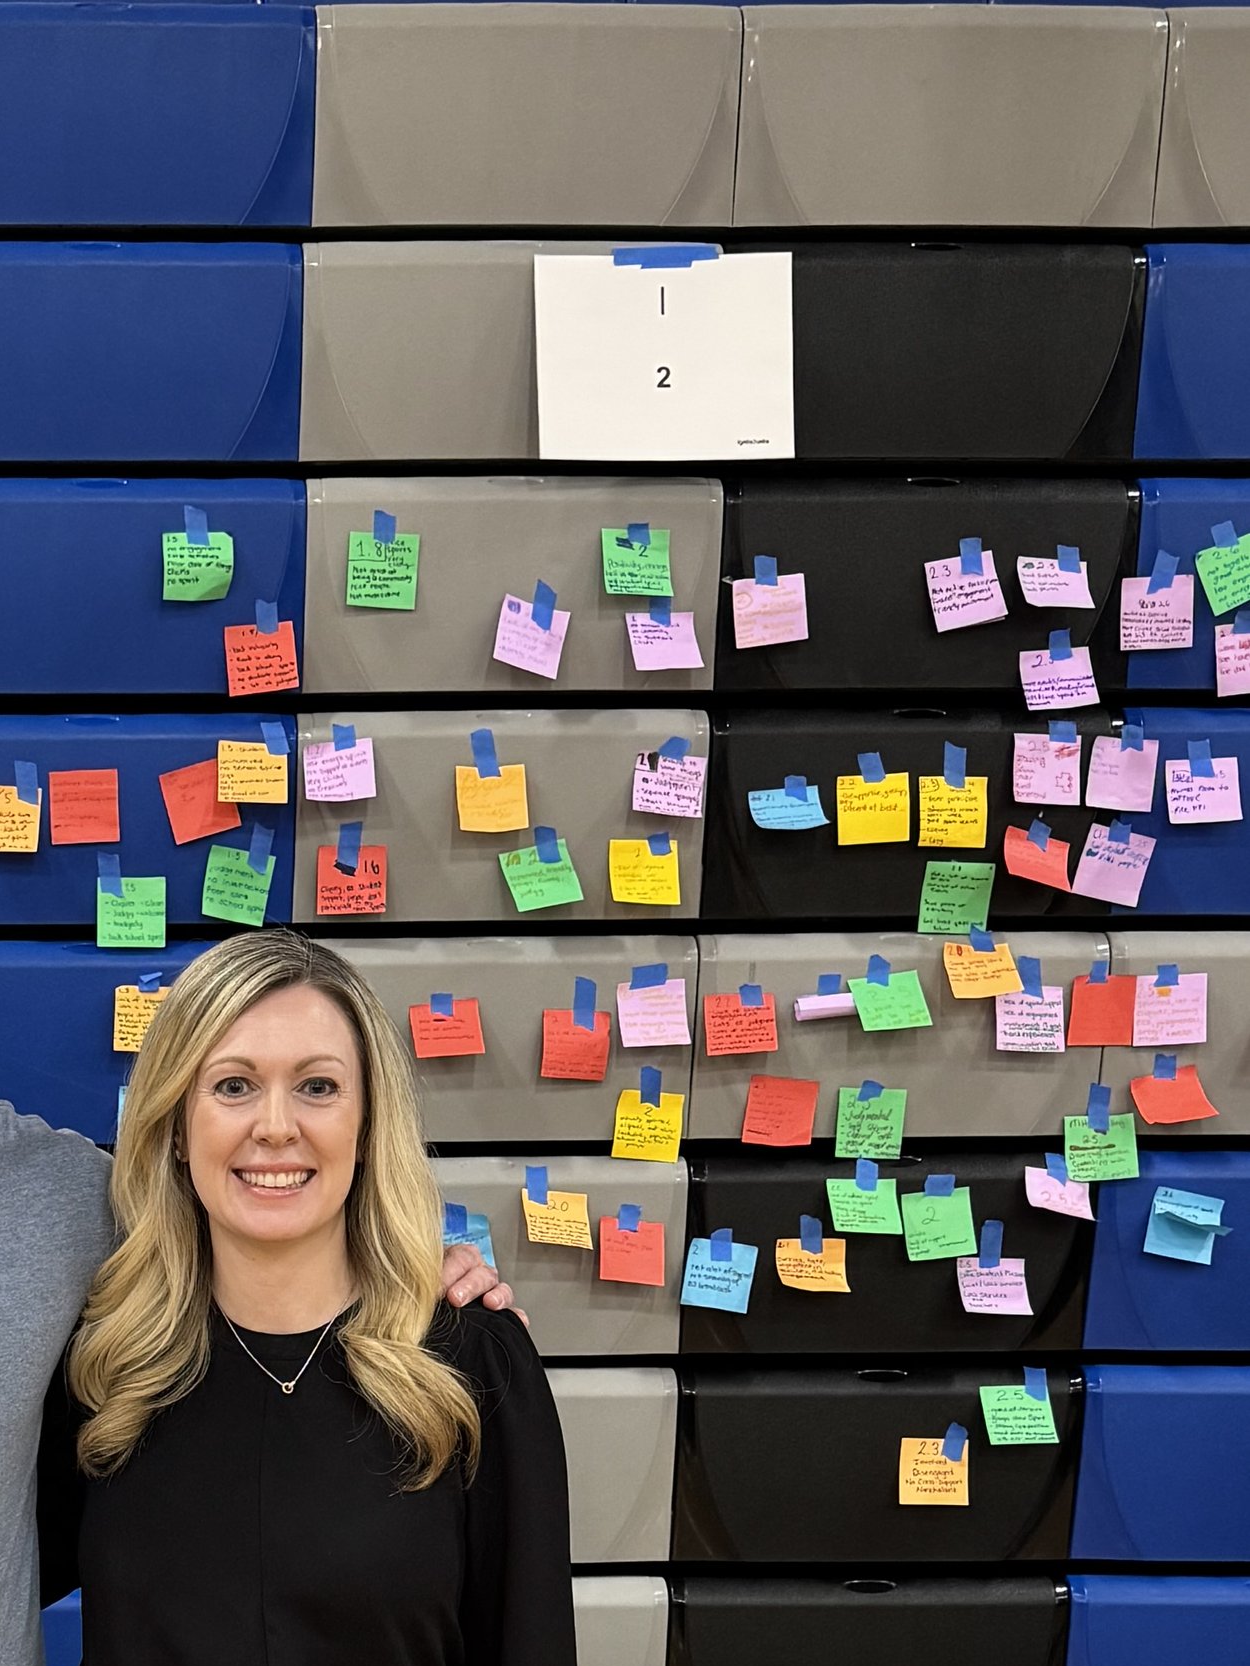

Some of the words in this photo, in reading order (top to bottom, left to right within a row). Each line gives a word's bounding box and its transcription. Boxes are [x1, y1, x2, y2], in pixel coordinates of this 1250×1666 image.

[656, 366, 671, 388] 2
[928, 565, 951, 579] 2.3
[921, 1206, 940, 1226] 2
[918, 1441, 939, 1456] 2.3
